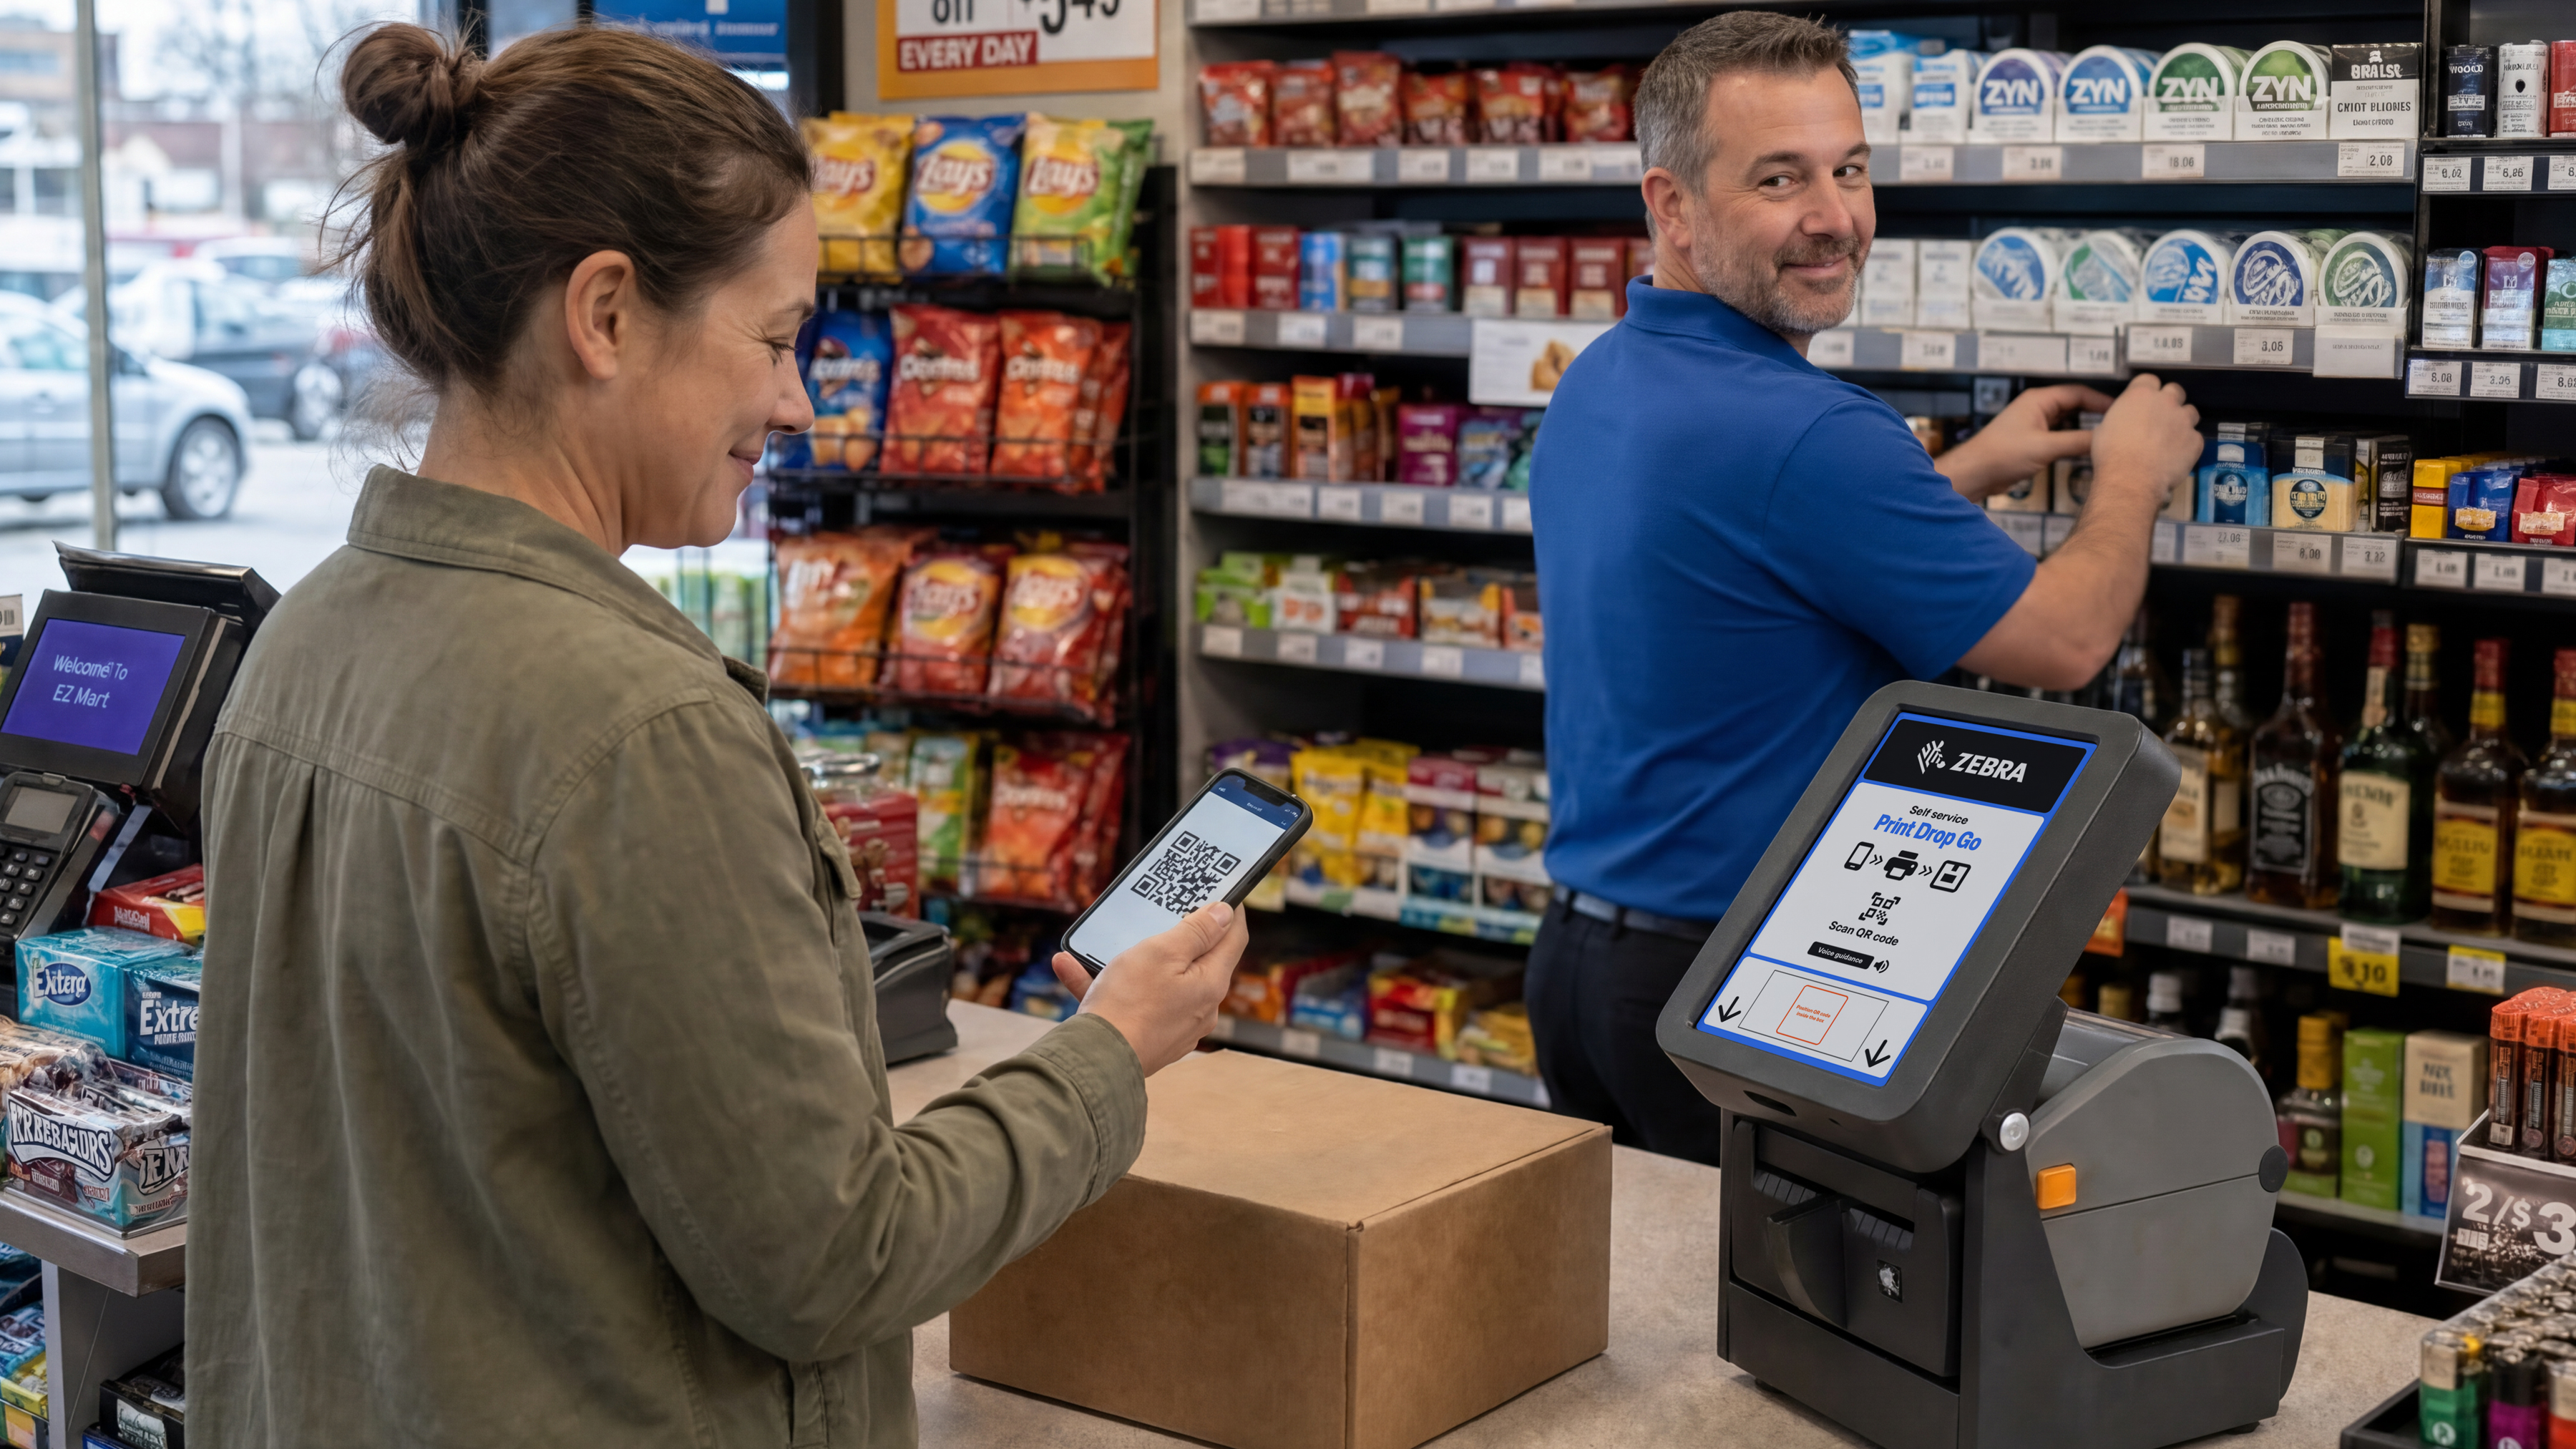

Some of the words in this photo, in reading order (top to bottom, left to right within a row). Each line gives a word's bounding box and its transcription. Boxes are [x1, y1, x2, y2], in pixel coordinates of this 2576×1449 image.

[899, 37, 979, 70] EVERY
[981, 34, 1034, 65] DAY
[1984, 79, 2039, 106] ZYN
[2070, 77, 2125, 104] ZYN
[2160, 77, 2218, 103] ZYN
[2251, 75, 2311, 102] ZYN
[54, 654, 110, 678] Welcome
[114, 663, 128, 680] To
[52, 683, 75, 703] EZ
[74, 687, 110, 708] Mart
[1949, 752, 2027, 783] ZEBRA
[1909, 805, 1931, 817] Self
[1931, 810, 1968, 824] service
[1873, 814, 1916, 837] Print
[1913, 821, 1956, 849] Drop
[1956, 831, 1982, 851] Go
[1828, 920, 1855, 935] Scan
[1855, 927, 1873, 940] QR
[1873, 932, 1899, 946] code
[1818, 947, 1835, 957] Voice
[1834, 952, 1863, 964] guidance
[1796, 1005, 1813, 1013] Position
